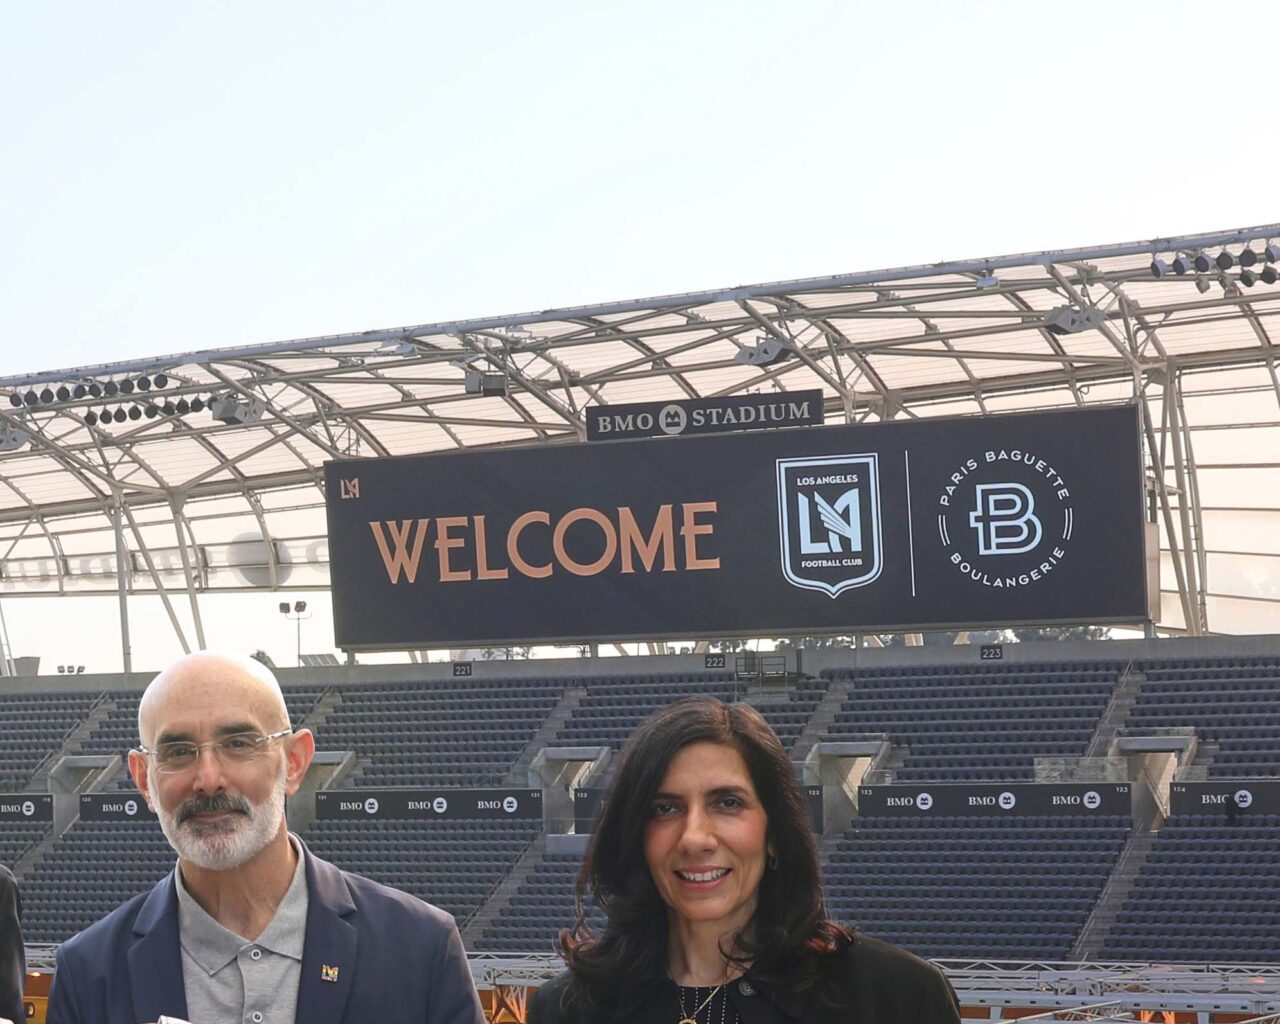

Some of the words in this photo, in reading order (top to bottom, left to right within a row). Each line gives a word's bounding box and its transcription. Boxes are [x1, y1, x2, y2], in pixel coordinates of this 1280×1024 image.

[598, 413, 654, 433] BMO
[692, 401, 811, 427] STADIUM
[797, 476, 815, 486] LOS
[816, 474, 859, 485] ANGELES
[939, 458, 978, 506] PARIS
[985, 450, 1069, 500] BAGUETTE
[368, 501, 721, 585] WELCOME
[801, 559, 841, 568] FOOTBALL
[842, 558, 863, 567] CLUB
[950, 546, 1065, 588] BOULANGERIE
[982, 648, 1001, 658] 223
[706, 657, 724, 667] 222
[455, 665, 470, 675] 221
[477, 800, 501, 809] BMO
[887, 797, 914, 806] BMO
[968, 796, 996, 806] BMO
[1052, 795, 1081, 805] BMO
[0, 804, 21, 813] BMO
[102, 804, 124, 813] BMO
[340, 802, 363, 811] BMO
[408, 801, 431, 810] BMO
